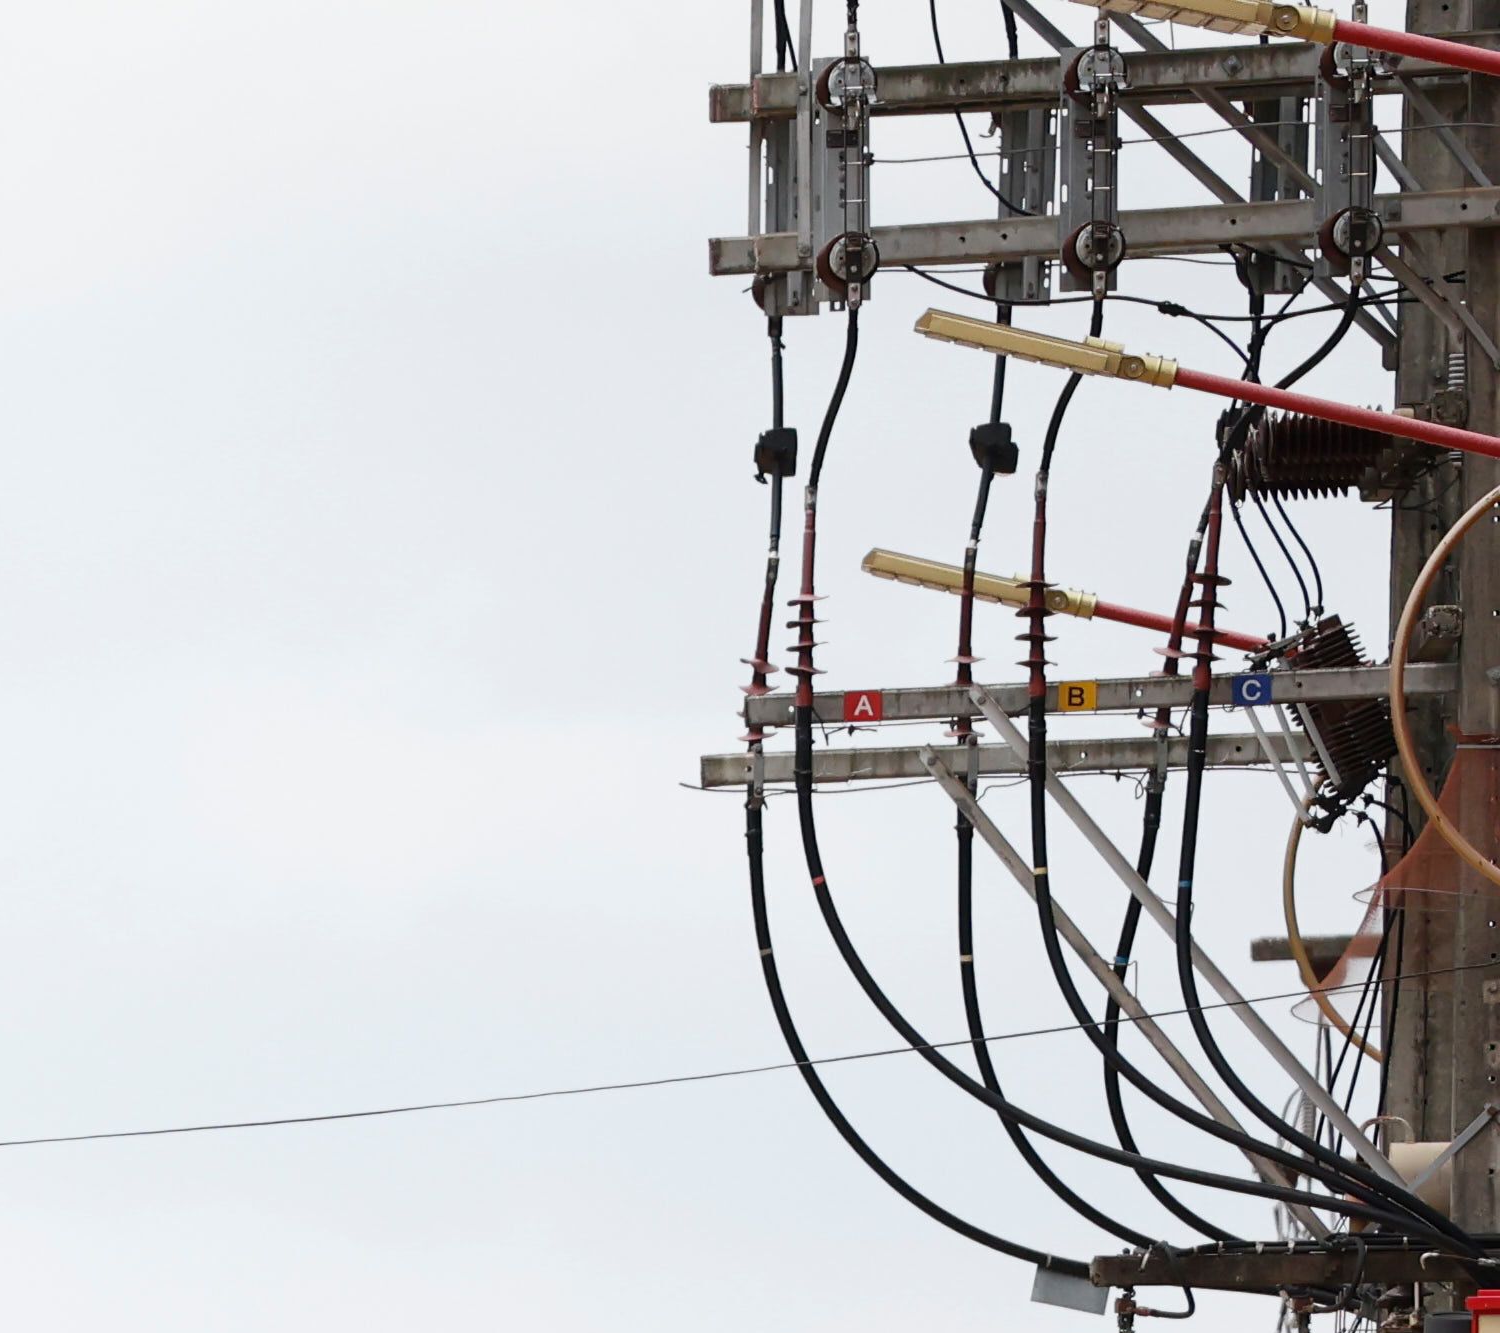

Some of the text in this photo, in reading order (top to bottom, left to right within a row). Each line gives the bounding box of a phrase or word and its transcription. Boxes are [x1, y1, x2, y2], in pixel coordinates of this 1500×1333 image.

[1069, 686, 1085, 705] B
[1242, 677, 1261, 700] C
[854, 692, 873, 716] A
